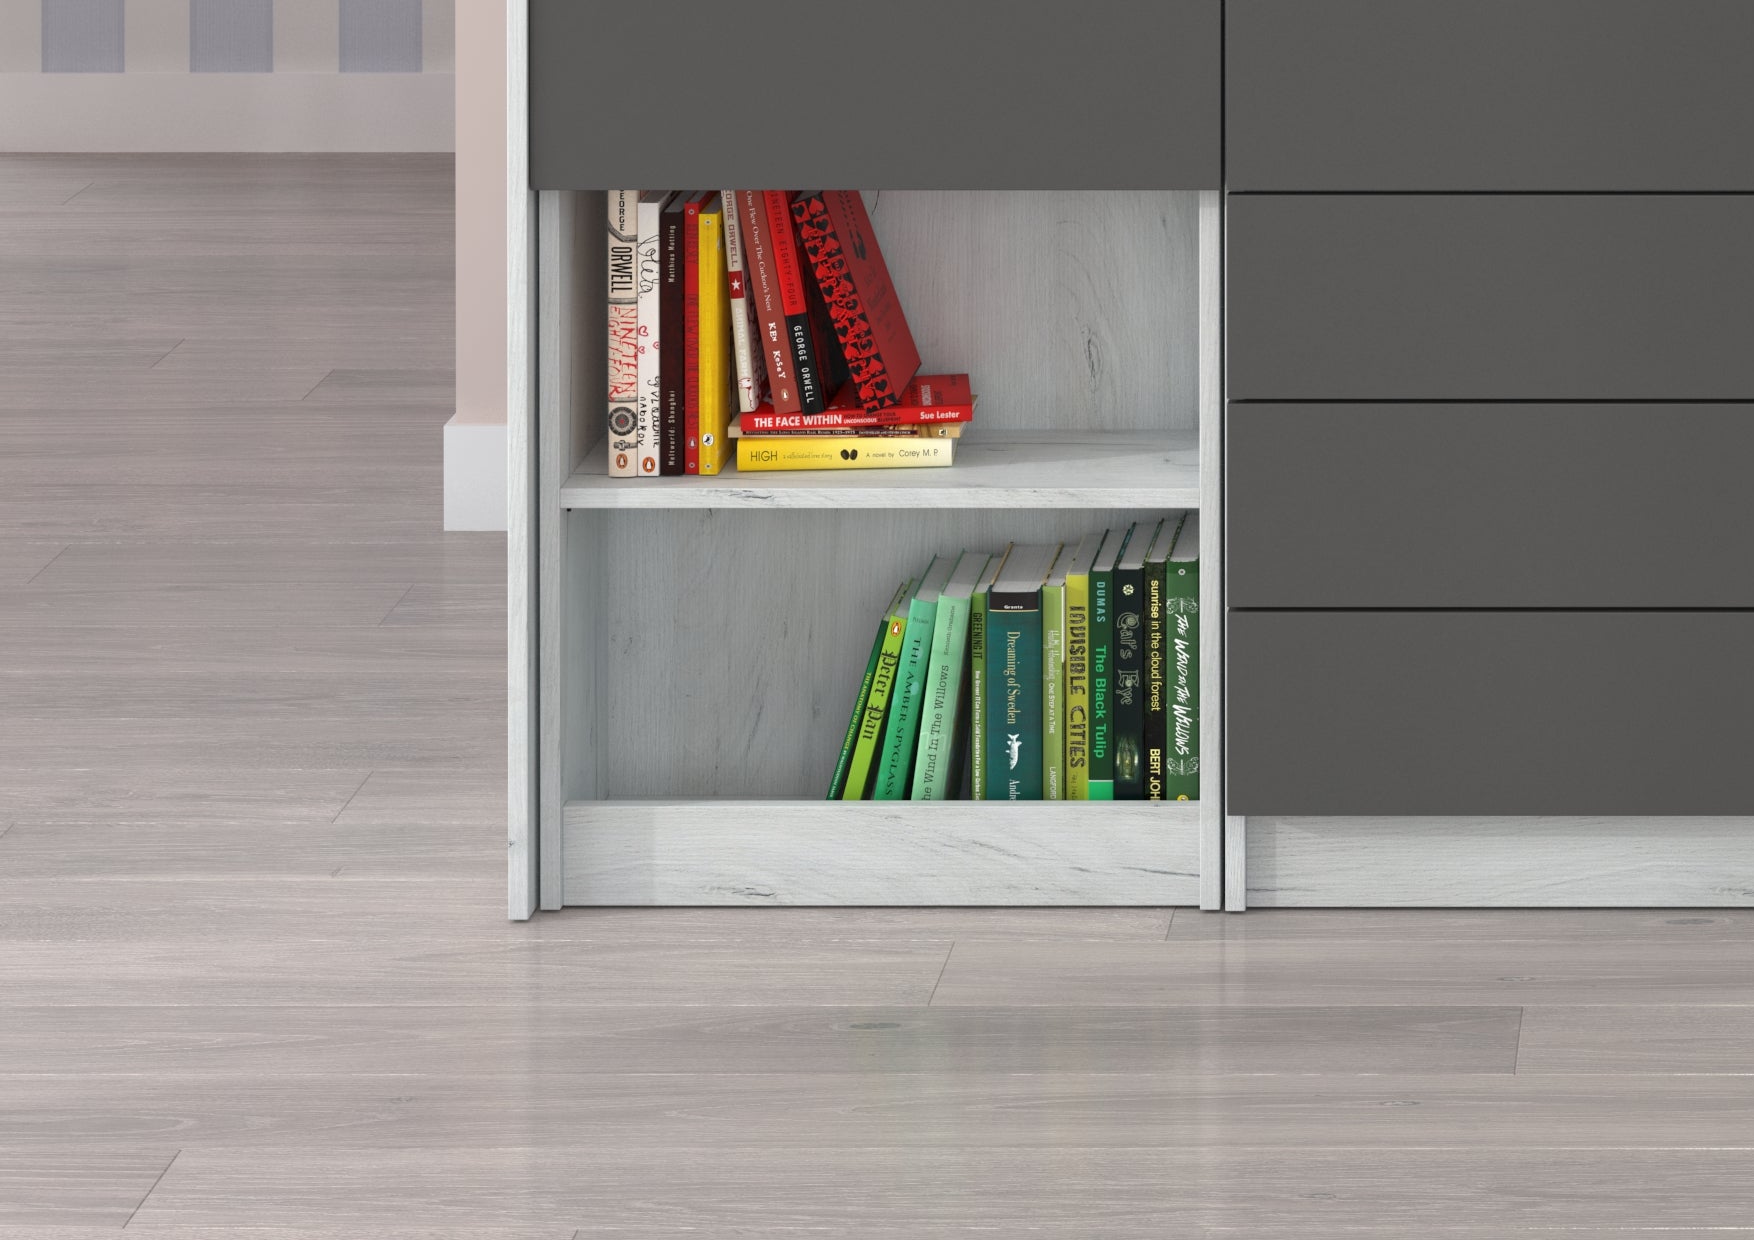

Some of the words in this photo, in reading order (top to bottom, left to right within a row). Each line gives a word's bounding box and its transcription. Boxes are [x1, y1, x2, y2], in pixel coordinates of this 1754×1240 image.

[728, 224, 737, 267] ORWELL
[611, 246, 632, 293] ORWELL
[752, 227, 760, 244] Over
[756, 245, 764, 260] The
[764, 294, 772, 311] Nest
[620, 307, 638, 393] NINETEEN
[793, 325, 807, 361] GEORGE
[801, 367, 814, 403] ORWELL
[668, 390, 676, 423] Shanghai
[754, 417, 773, 427] THE
[775, 416, 800, 427] FACE
[802, 415, 842, 426] WITHIN
[920, 412, 934, 420] Sue
[936, 411, 960, 419] Lester
[751, 451, 777, 461] HIGH
[923, 449, 931, 457] M.
[1096, 581, 1106, 622] DUMAS
[1151, 579, 1160, 619] sunrise
[972, 612, 982, 649] GREENING
[1151, 622, 1160, 630] in
[1151, 632, 1160, 649] the
[1175, 614, 1189, 636] THE
[910, 638, 921, 667] THE
[973, 650, 982, 660] IT
[1003, 631, 1020, 675] Dreaming
[1095, 645, 1107, 673] The
[1151, 651, 1160, 677] cloud
[874, 649, 897, 697] Peter
[934, 665, 949, 710] Willows
[1008, 678, 1020, 688] of
[1116, 669, 1139, 705] Eye
[901, 672, 915, 722] AMBER
[1008, 690, 1021, 724] Sweden
[1095, 678, 1106, 719] Black
[1151, 678, 1160, 712] forest
[1174, 685, 1190, 703] THE
[862, 703, 883, 740] Pan
[931, 713, 942, 739] The
[1069, 705, 1086, 768] CITIES
[1173, 704, 1192, 756] WILLOWS
[929, 738, 939, 753] In
[1093, 723, 1106, 759] Tulip
[885, 727, 905, 796] SPYGLASS
[924, 754, 937, 784] Wind
[1150, 748, 1160, 776] BERT
[1150, 779, 1160, 800] JOH
